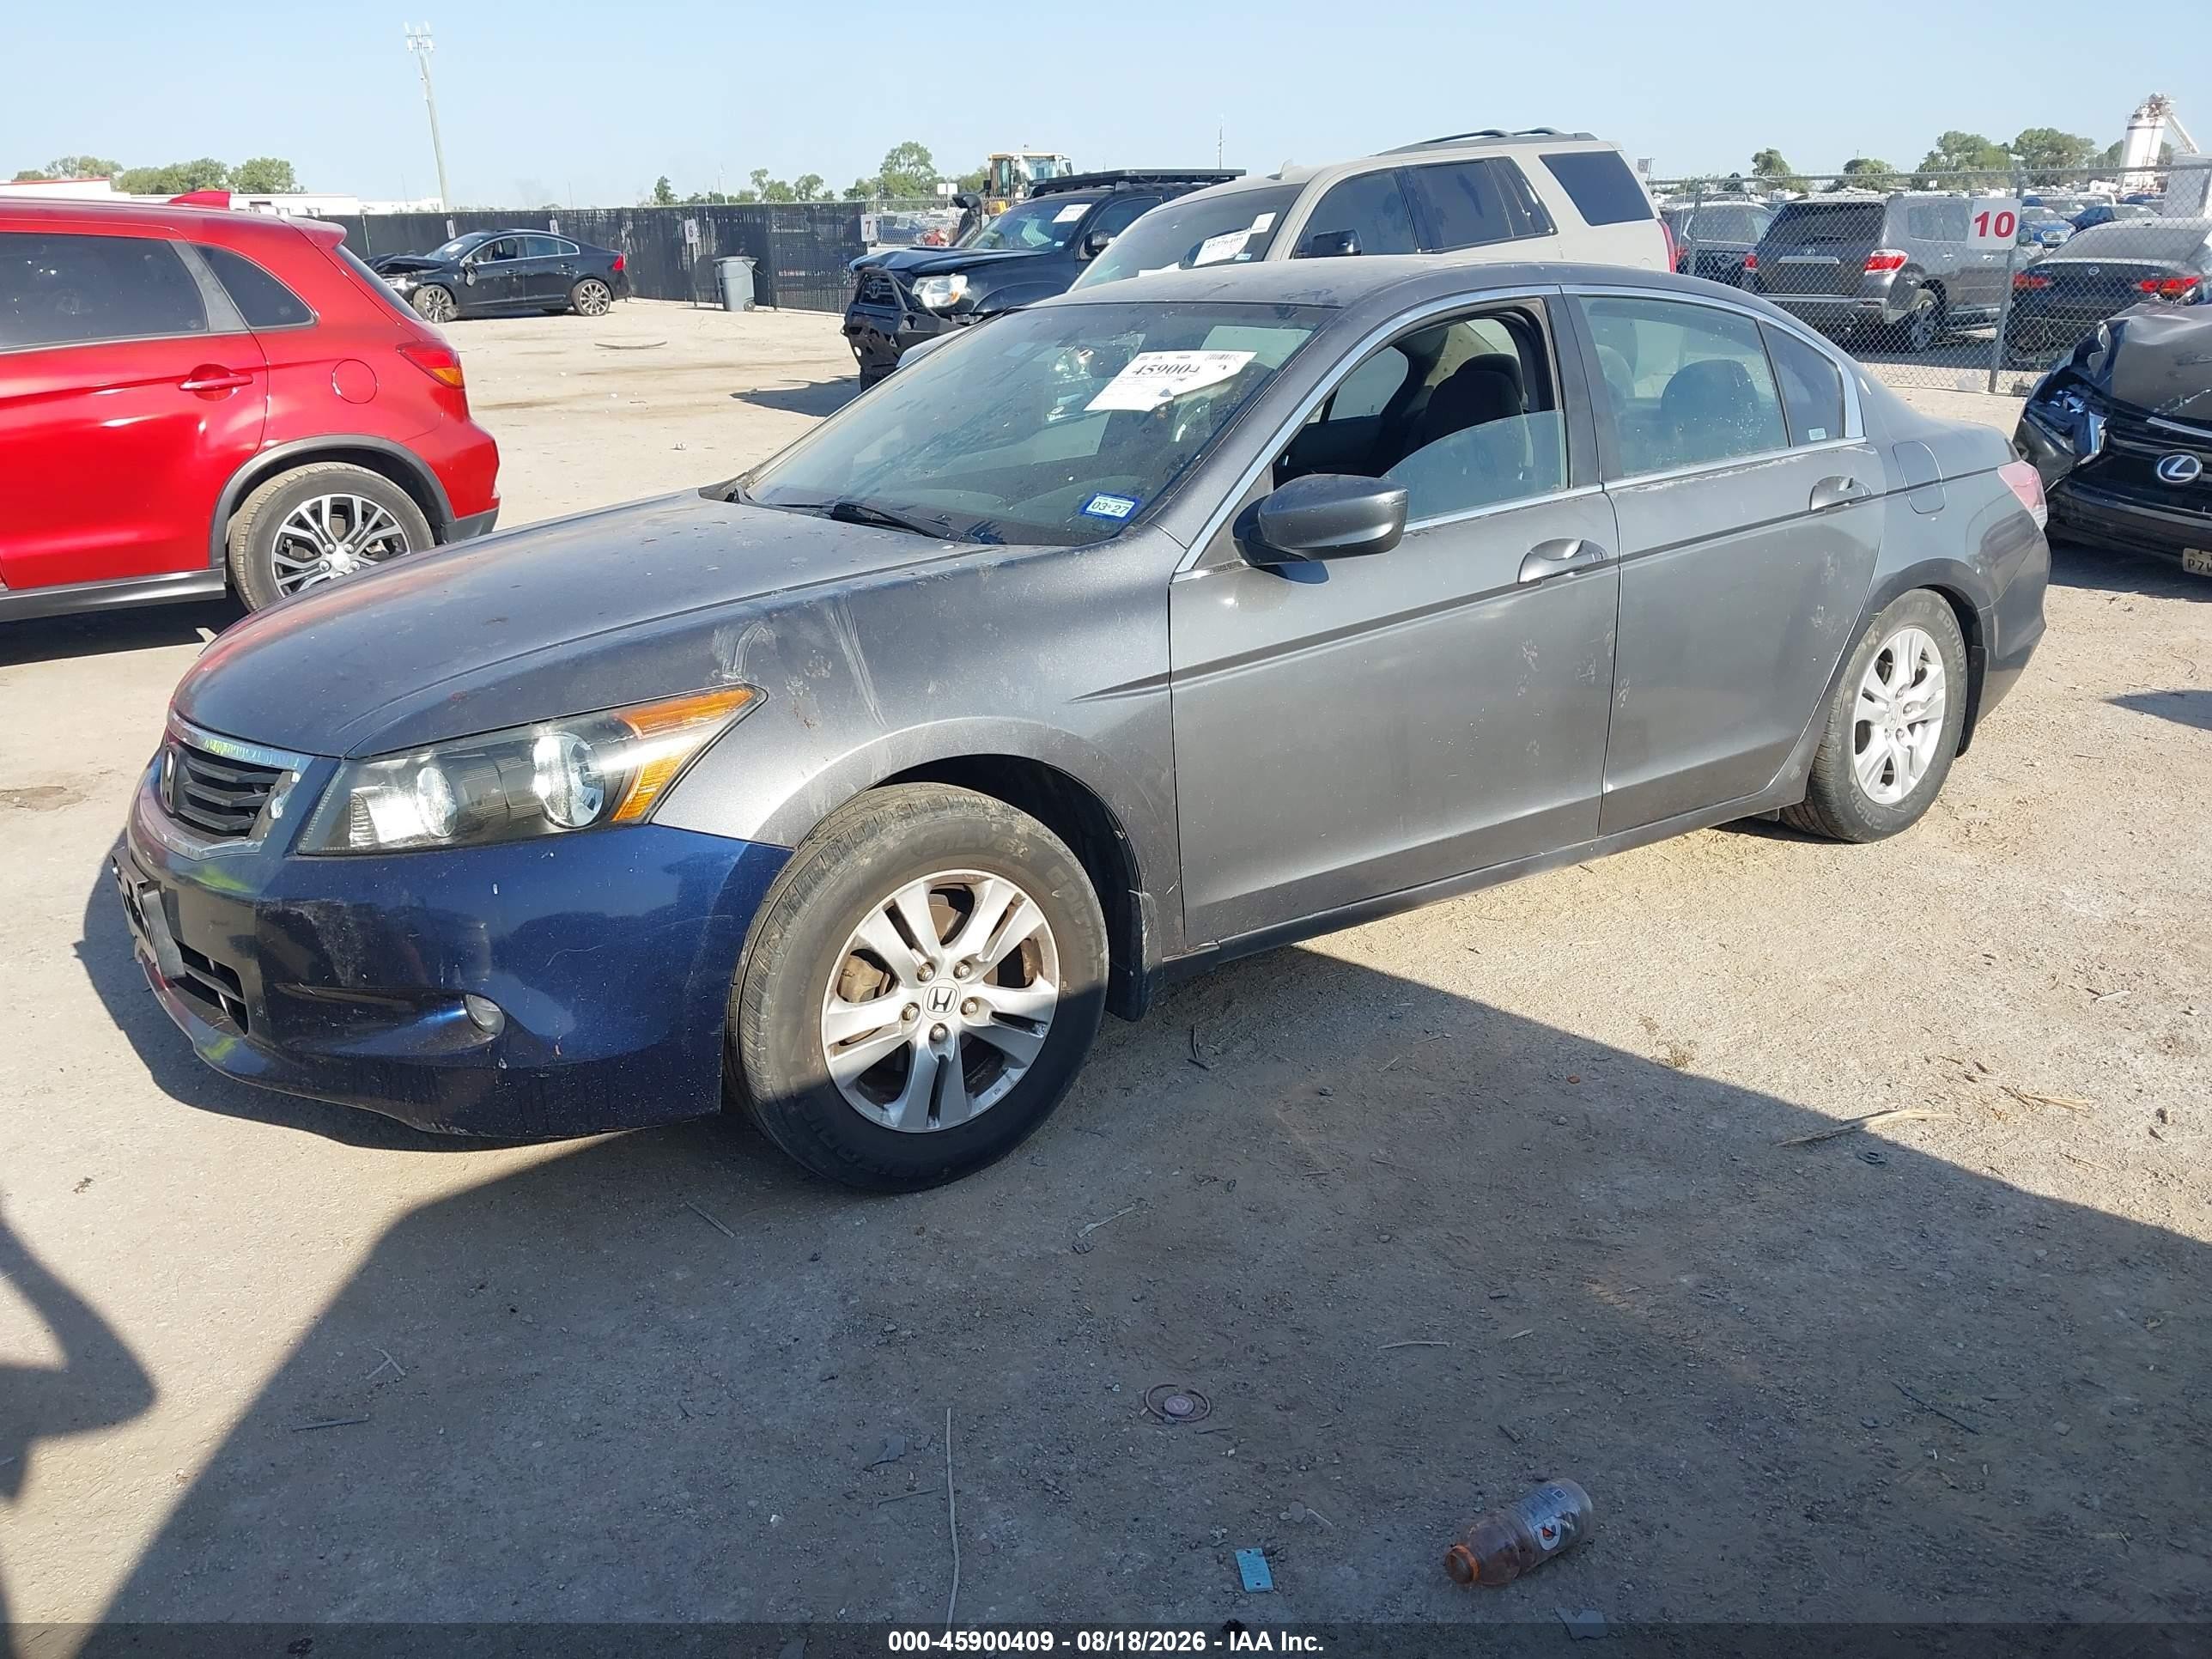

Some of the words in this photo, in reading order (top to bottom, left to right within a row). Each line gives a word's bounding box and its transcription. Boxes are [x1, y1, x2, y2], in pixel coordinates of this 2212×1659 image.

[688, 225, 694, 238] 6
[865, 220, 872, 235] 7
[1974, 210, 2016, 238] 10
